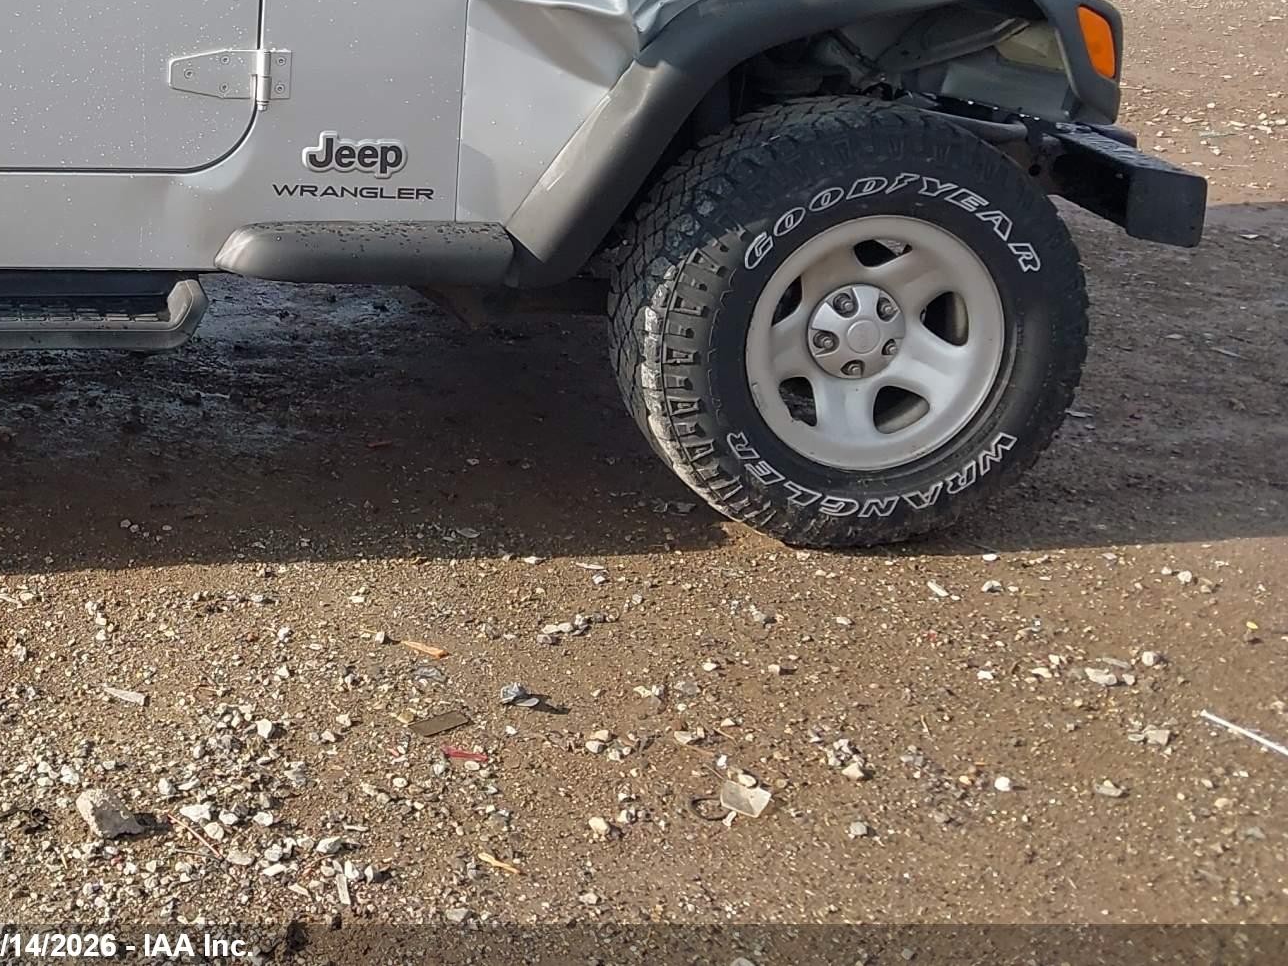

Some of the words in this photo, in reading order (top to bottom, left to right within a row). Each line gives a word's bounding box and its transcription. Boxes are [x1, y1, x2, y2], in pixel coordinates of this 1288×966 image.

[306, 135, 405, 176] Jeep
[272, 183, 435, 201] WRANGLER
[743, 172, 1042, 273] GOODYEAR
[725, 430, 1018, 519] WRANGLER
